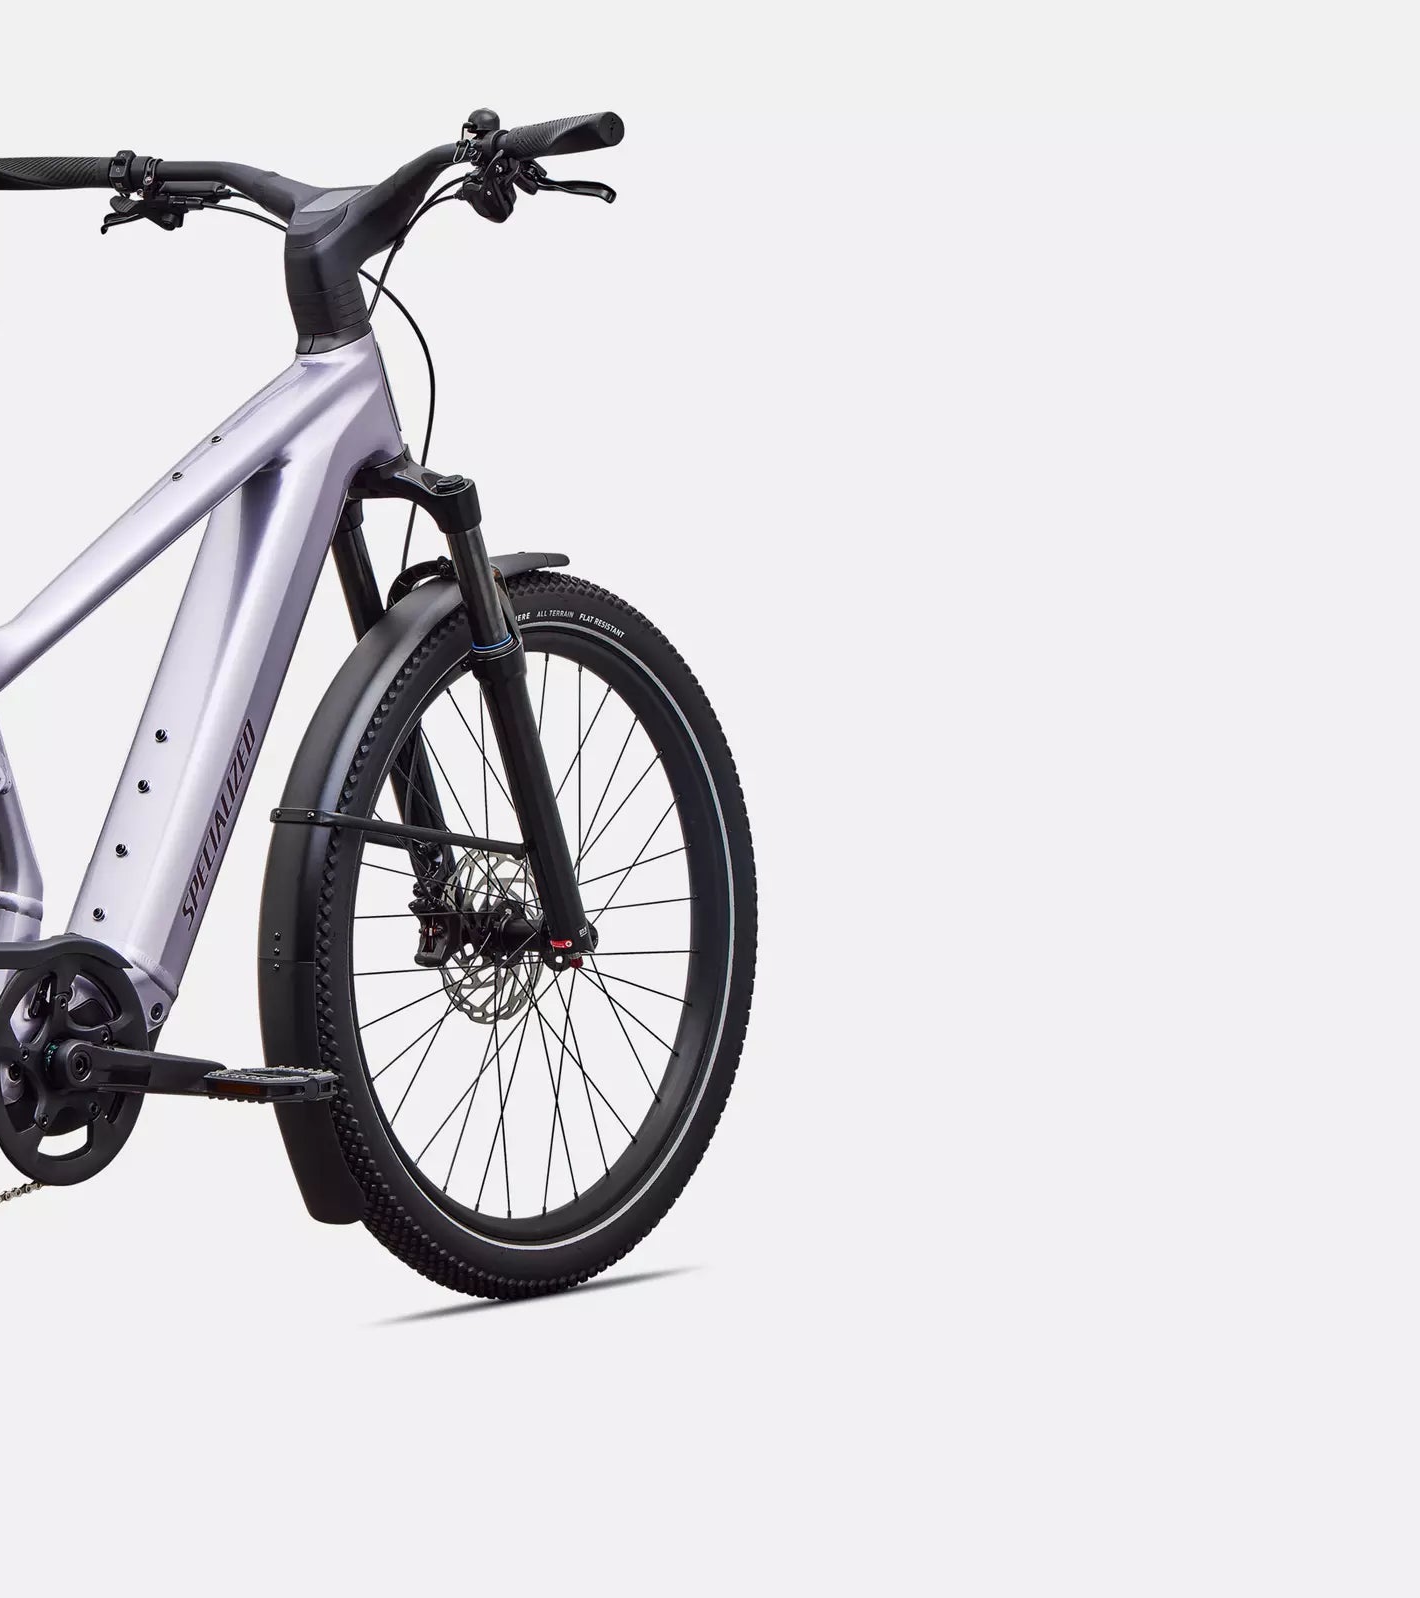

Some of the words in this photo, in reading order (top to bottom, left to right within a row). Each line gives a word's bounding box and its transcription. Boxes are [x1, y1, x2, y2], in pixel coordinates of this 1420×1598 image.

[536, 610, 548, 618] ALL
[549, 609, 575, 618] TERRAIN
[579, 613, 595, 623] FLAT
[594, 619, 625, 638] RESISTANT
[182, 718, 256, 931] SPECIALIZED
